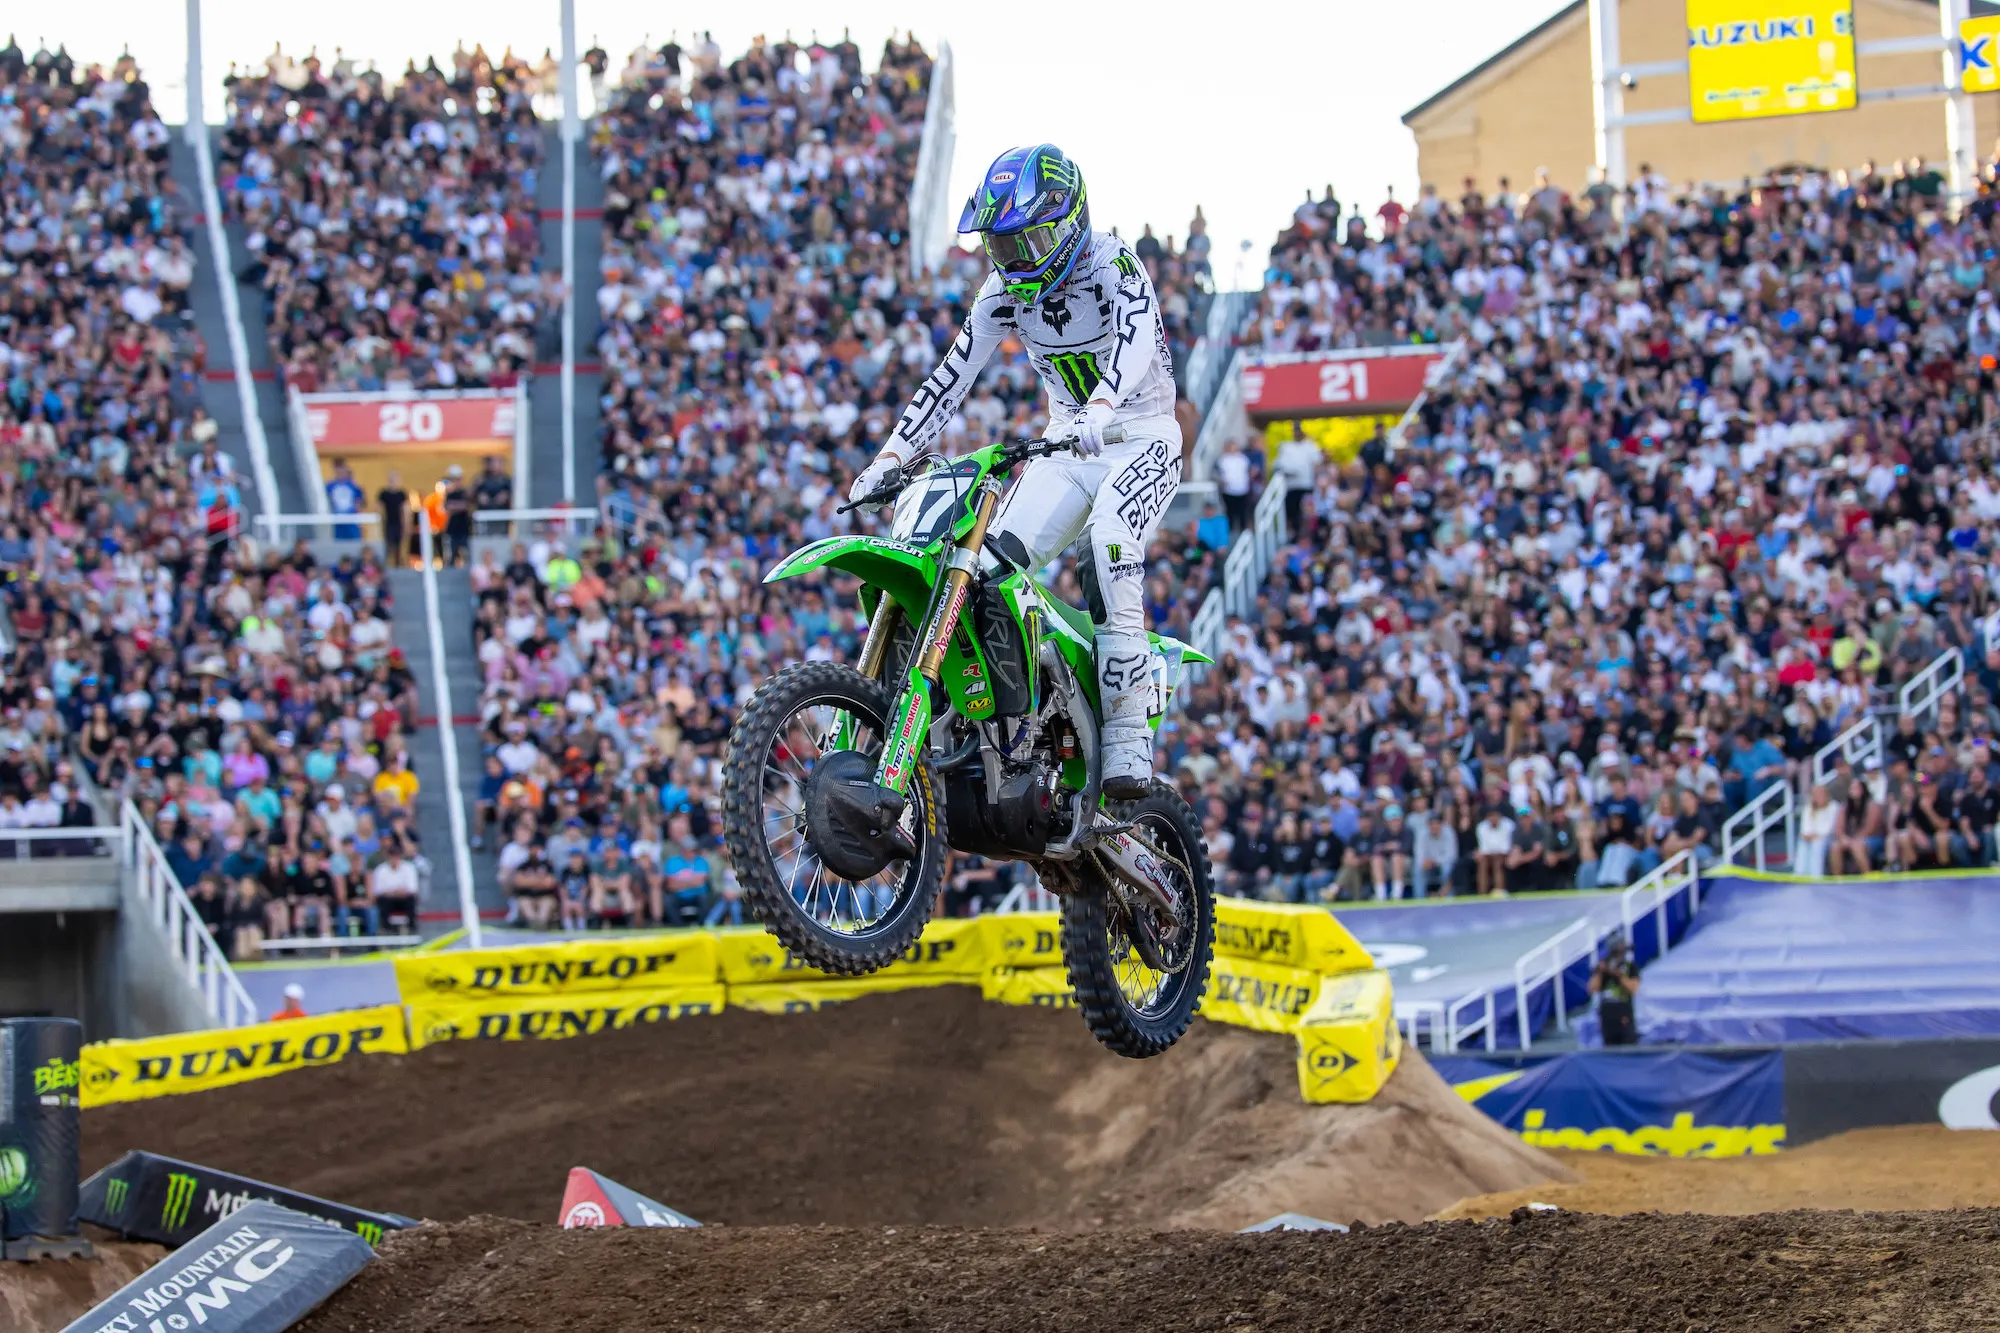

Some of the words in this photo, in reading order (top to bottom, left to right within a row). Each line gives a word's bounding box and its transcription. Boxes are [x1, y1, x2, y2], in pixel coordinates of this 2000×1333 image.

[1319, 361, 1368, 402] 21
[378, 402, 443, 441] 20
[1112, 440, 1168, 497] PRO
[869, 538, 926, 558] CIRCUIT
[923, 626, 937, 654] PRO
[933, 579, 953, 627] CIRCUIT
[902, 693, 922, 739] BRAKING
[913, 711, 927, 745] PISTONS
[873, 708, 902, 785] DUNLOP
[917, 762, 936, 837] DUNLOP
[1116, 833, 1131, 849] RK
[469, 952, 677, 988] DUNLOP
[131, 1026, 385, 1084] DUNLOP
[128, 1225, 261, 1319] MOUNTAIN
